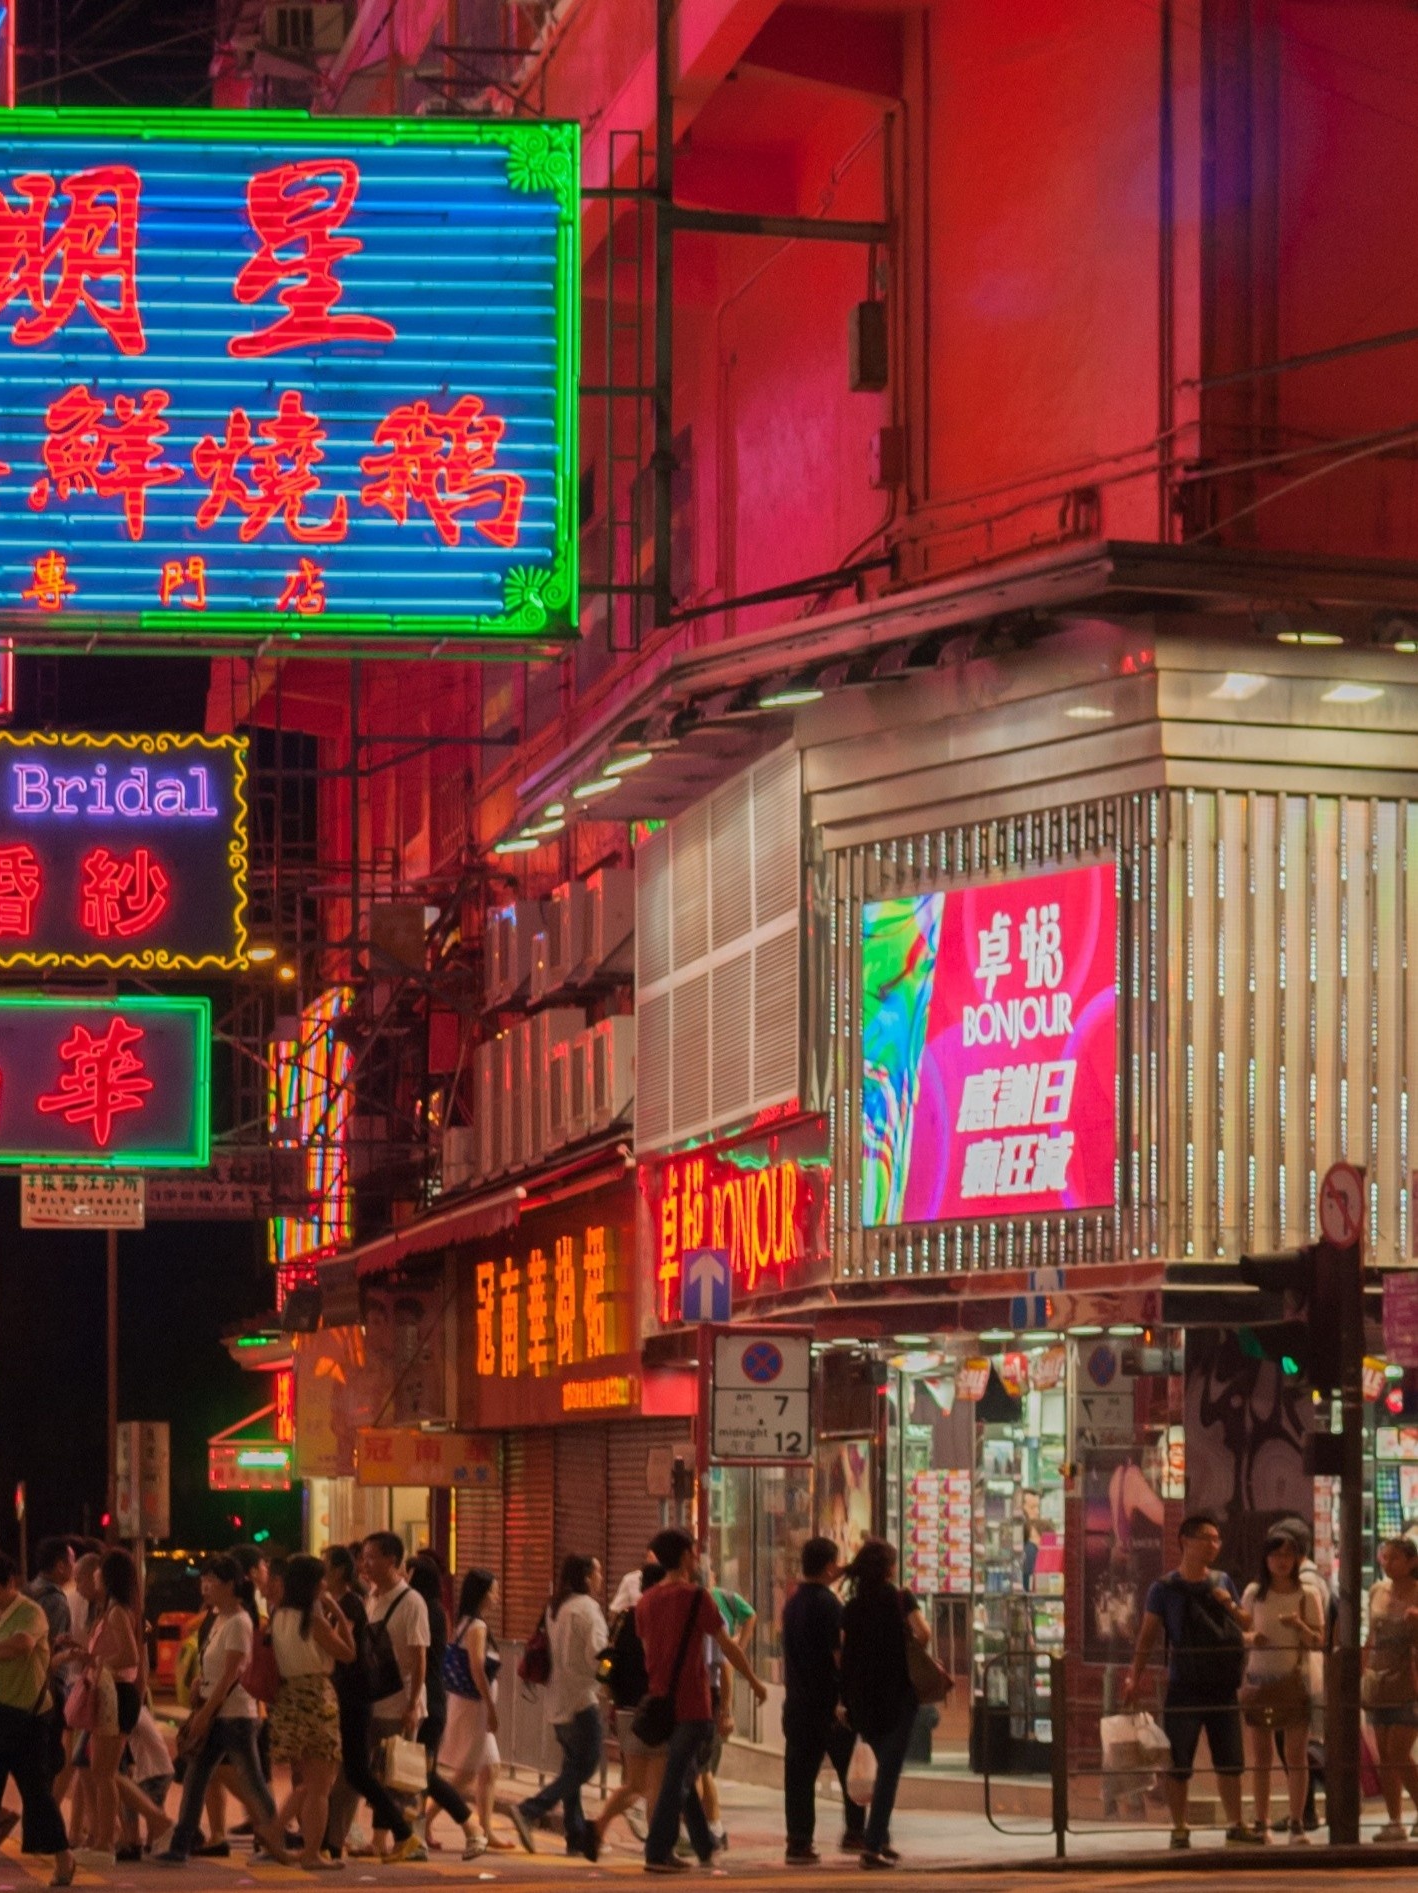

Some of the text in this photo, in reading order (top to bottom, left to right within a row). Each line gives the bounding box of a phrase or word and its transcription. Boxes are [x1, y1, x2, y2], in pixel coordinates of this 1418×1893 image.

[22, 550, 329, 615] 專門店
[14, 763, 218, 817] Bridal
[962, 992, 1075, 1050] BONJOUR
[956, 1059, 1077, 1133] 感謝日
[712, 1161, 799, 1291] BONJOUR
[719, 1427, 768, 1438] midnight
[774, 1395, 789, 1416] 7
[775, 1431, 802, 1453] 12
